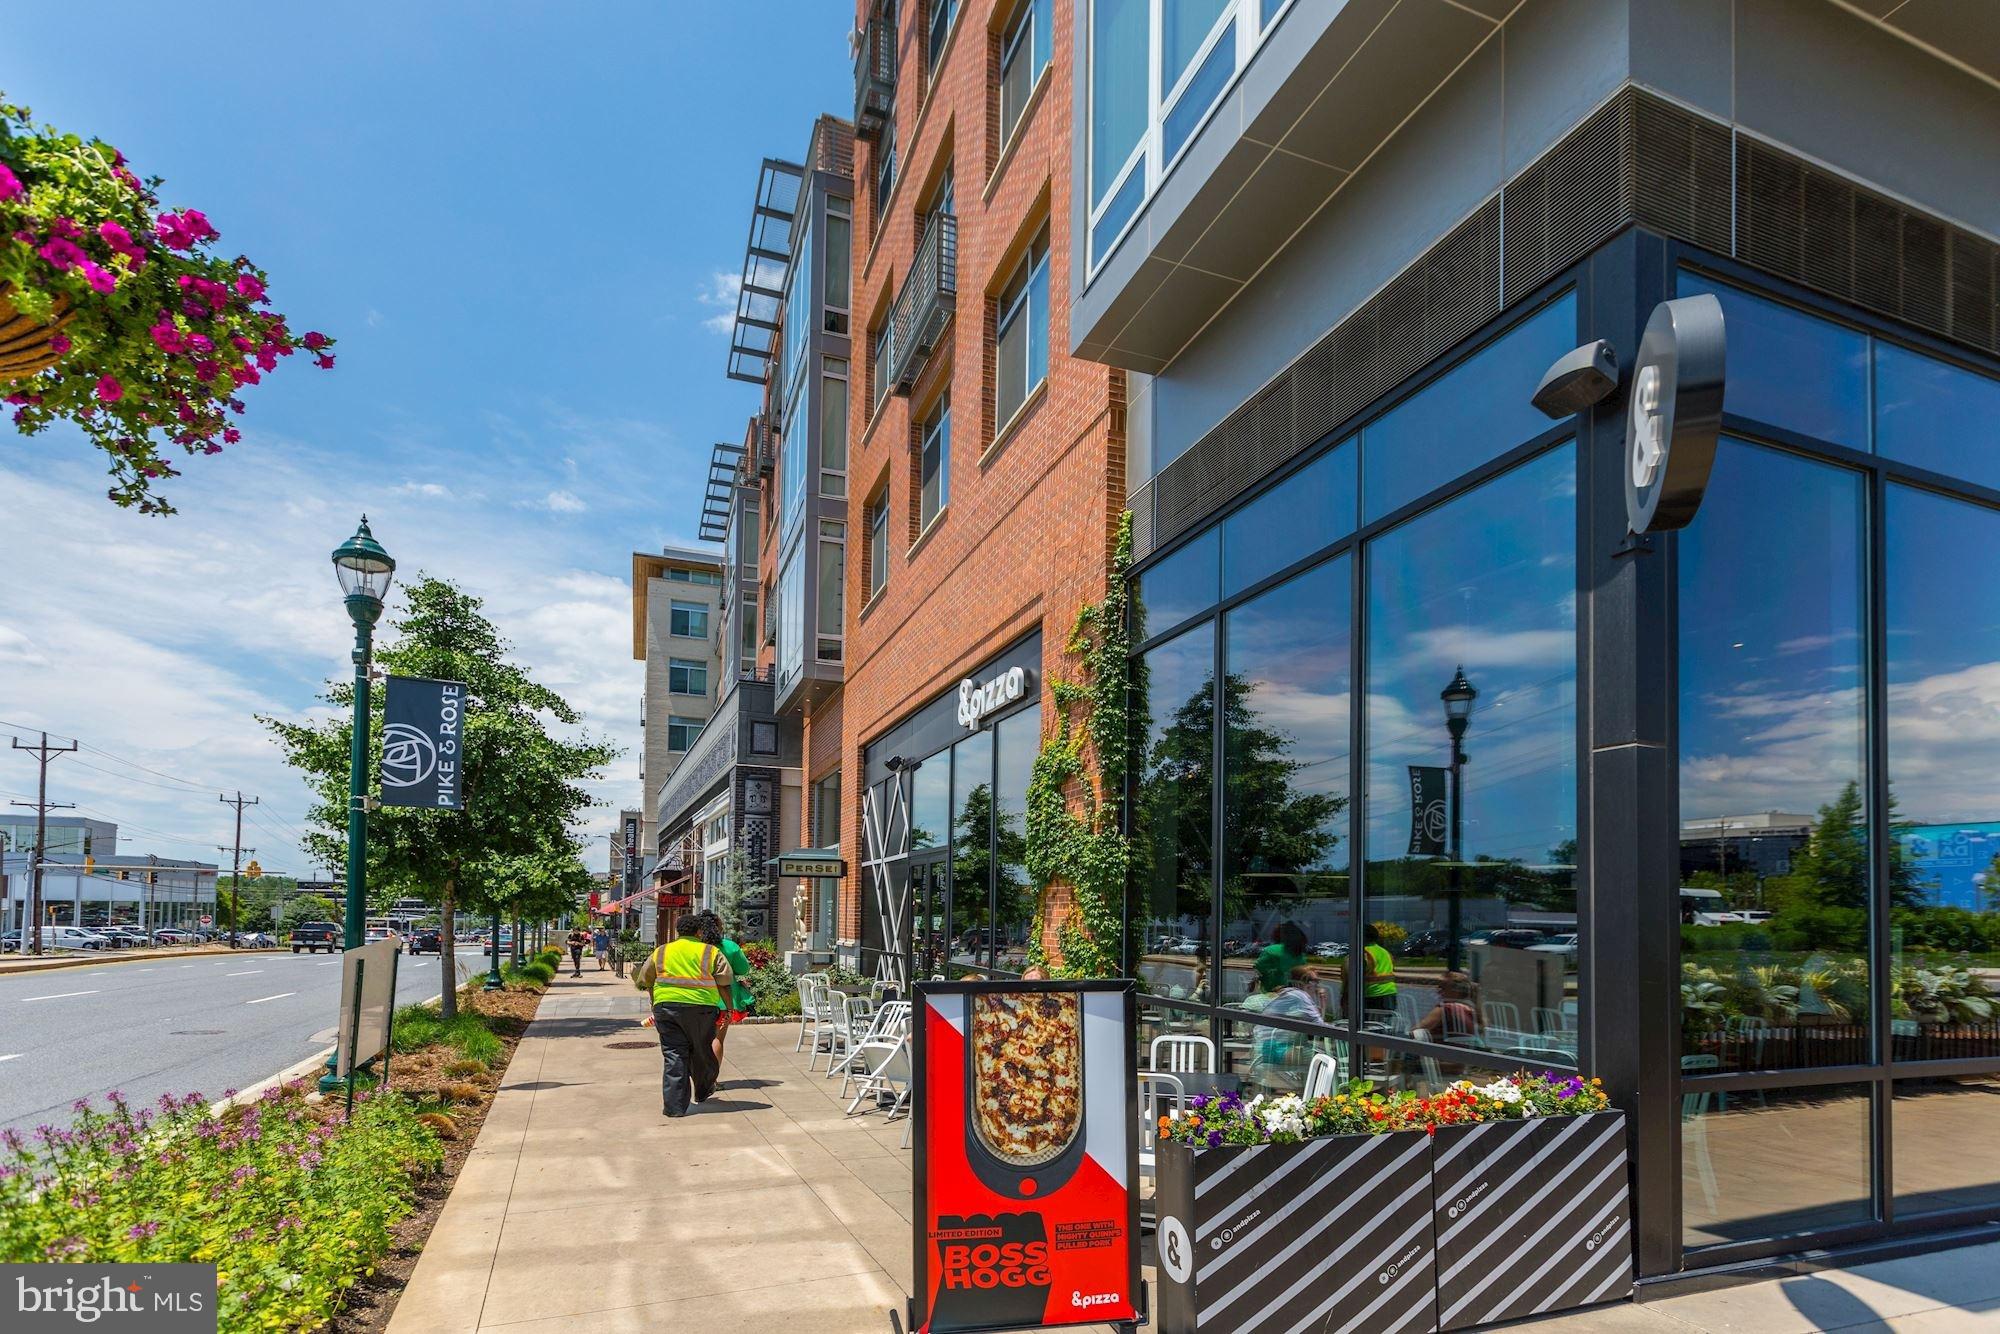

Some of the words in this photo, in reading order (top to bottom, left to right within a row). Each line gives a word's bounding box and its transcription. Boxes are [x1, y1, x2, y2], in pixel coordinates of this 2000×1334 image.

[440, 685, 459, 736] ROSE
[958, 667, 1024, 730] &pizza
[439, 740, 456, 755] &
[438, 760, 455, 806] PIKE
[928, 1231, 963, 1239] LIMITED
[965, 1229, 1000, 1237] EDITION
[1233, 1210, 1261, 1233] andpizza
[944, 1241, 1048, 1269] BOSS
[944, 1265, 1052, 1290] HOGG
[1071, 1290, 1120, 1309] &pizza
